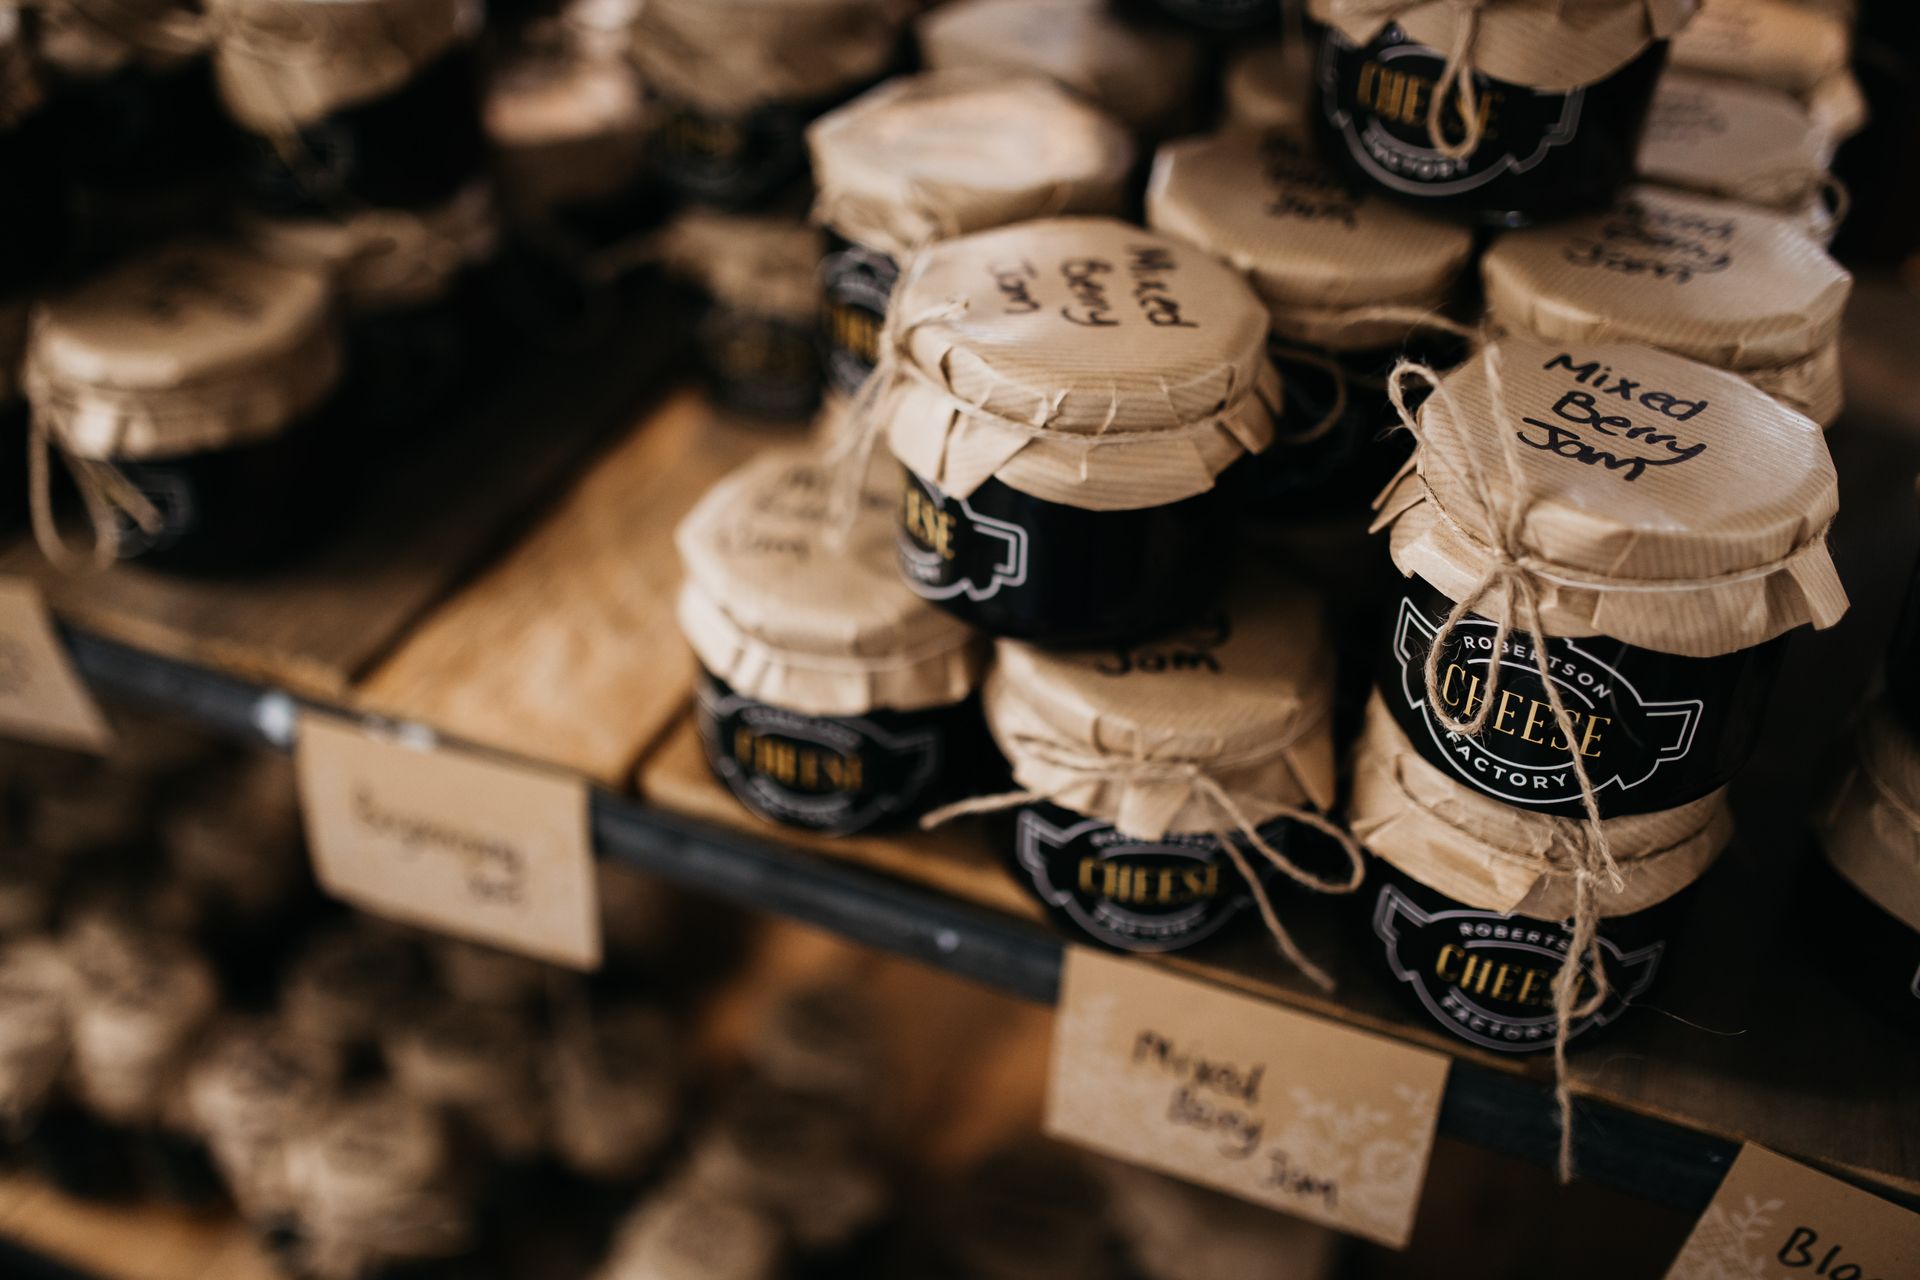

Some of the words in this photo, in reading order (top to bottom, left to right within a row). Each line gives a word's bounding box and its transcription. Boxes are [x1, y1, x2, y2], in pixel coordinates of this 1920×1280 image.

[1542, 352, 1710, 422] Mixed
[1516, 416, 1647, 482] Jam
[1552, 390, 1708, 467] Berry
[1446, 731, 1568, 790] FACTORY
